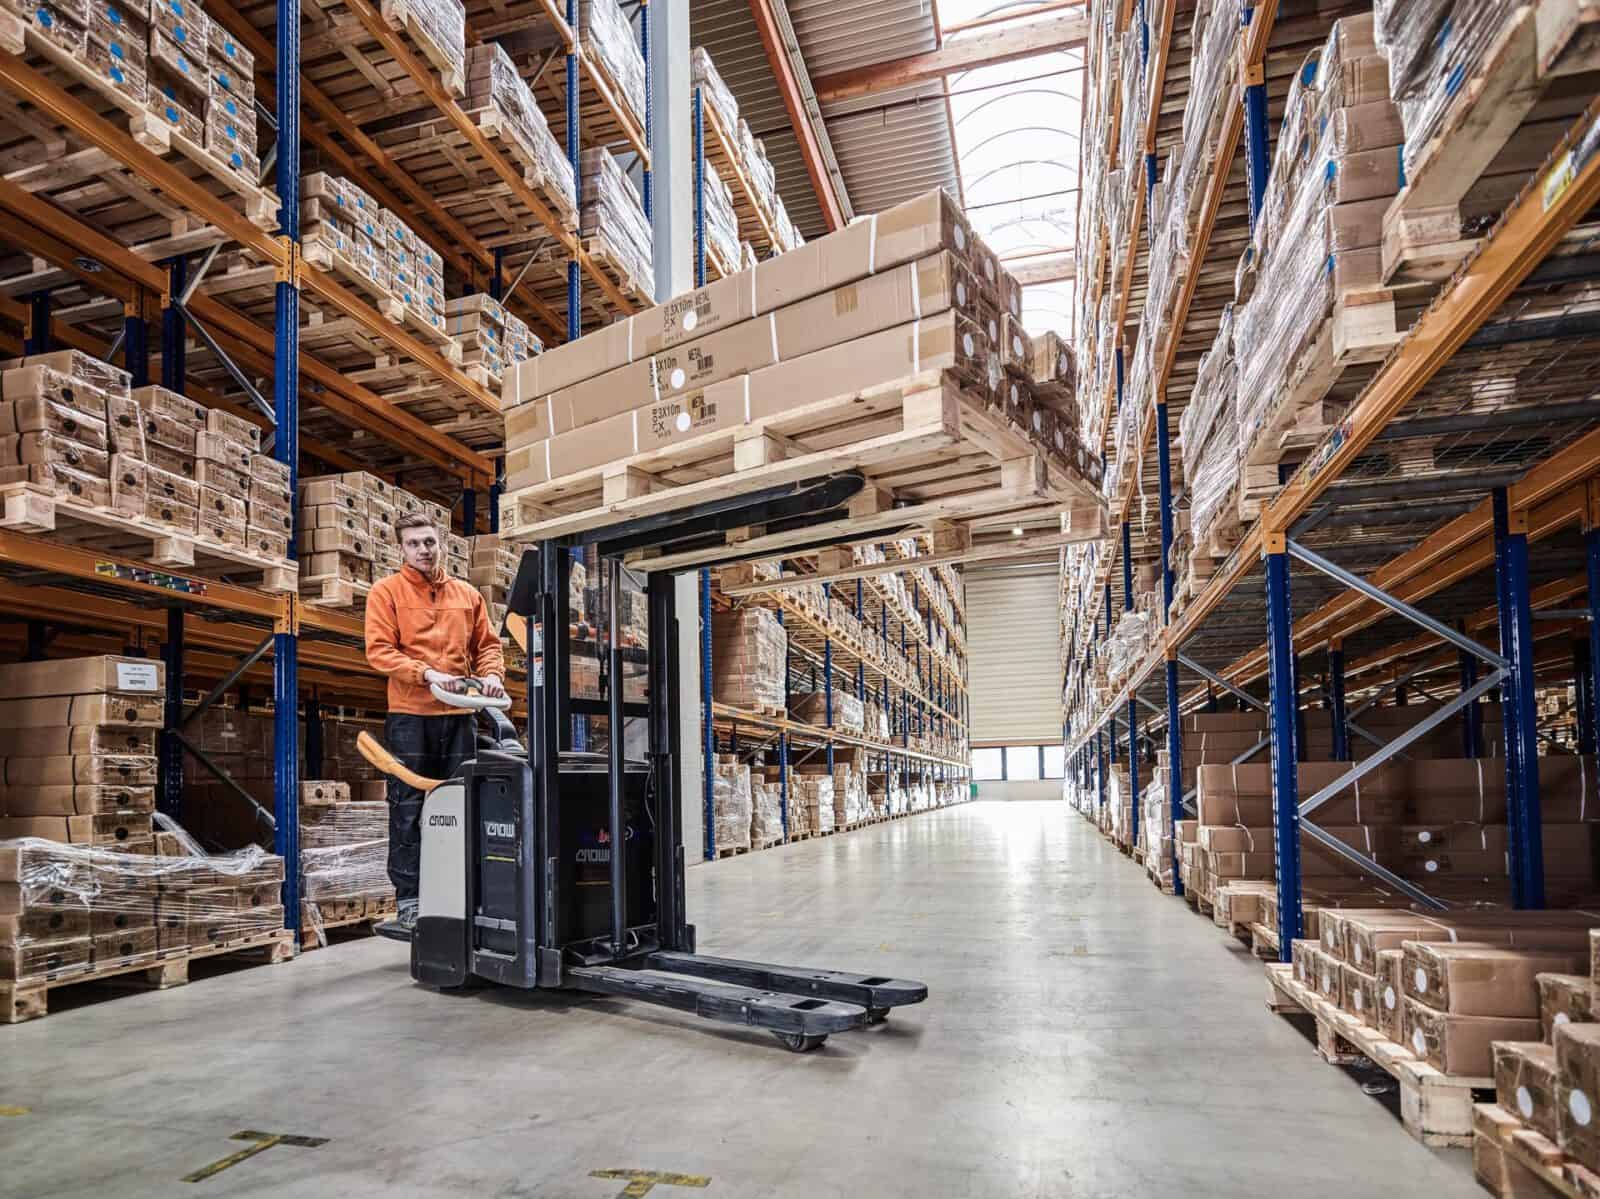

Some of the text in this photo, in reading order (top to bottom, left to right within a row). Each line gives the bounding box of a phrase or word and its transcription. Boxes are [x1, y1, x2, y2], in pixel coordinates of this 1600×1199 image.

[429, 815, 457, 826] CROWN
[486, 822, 515, 838] CROW
[576, 848, 610, 862] CROW
